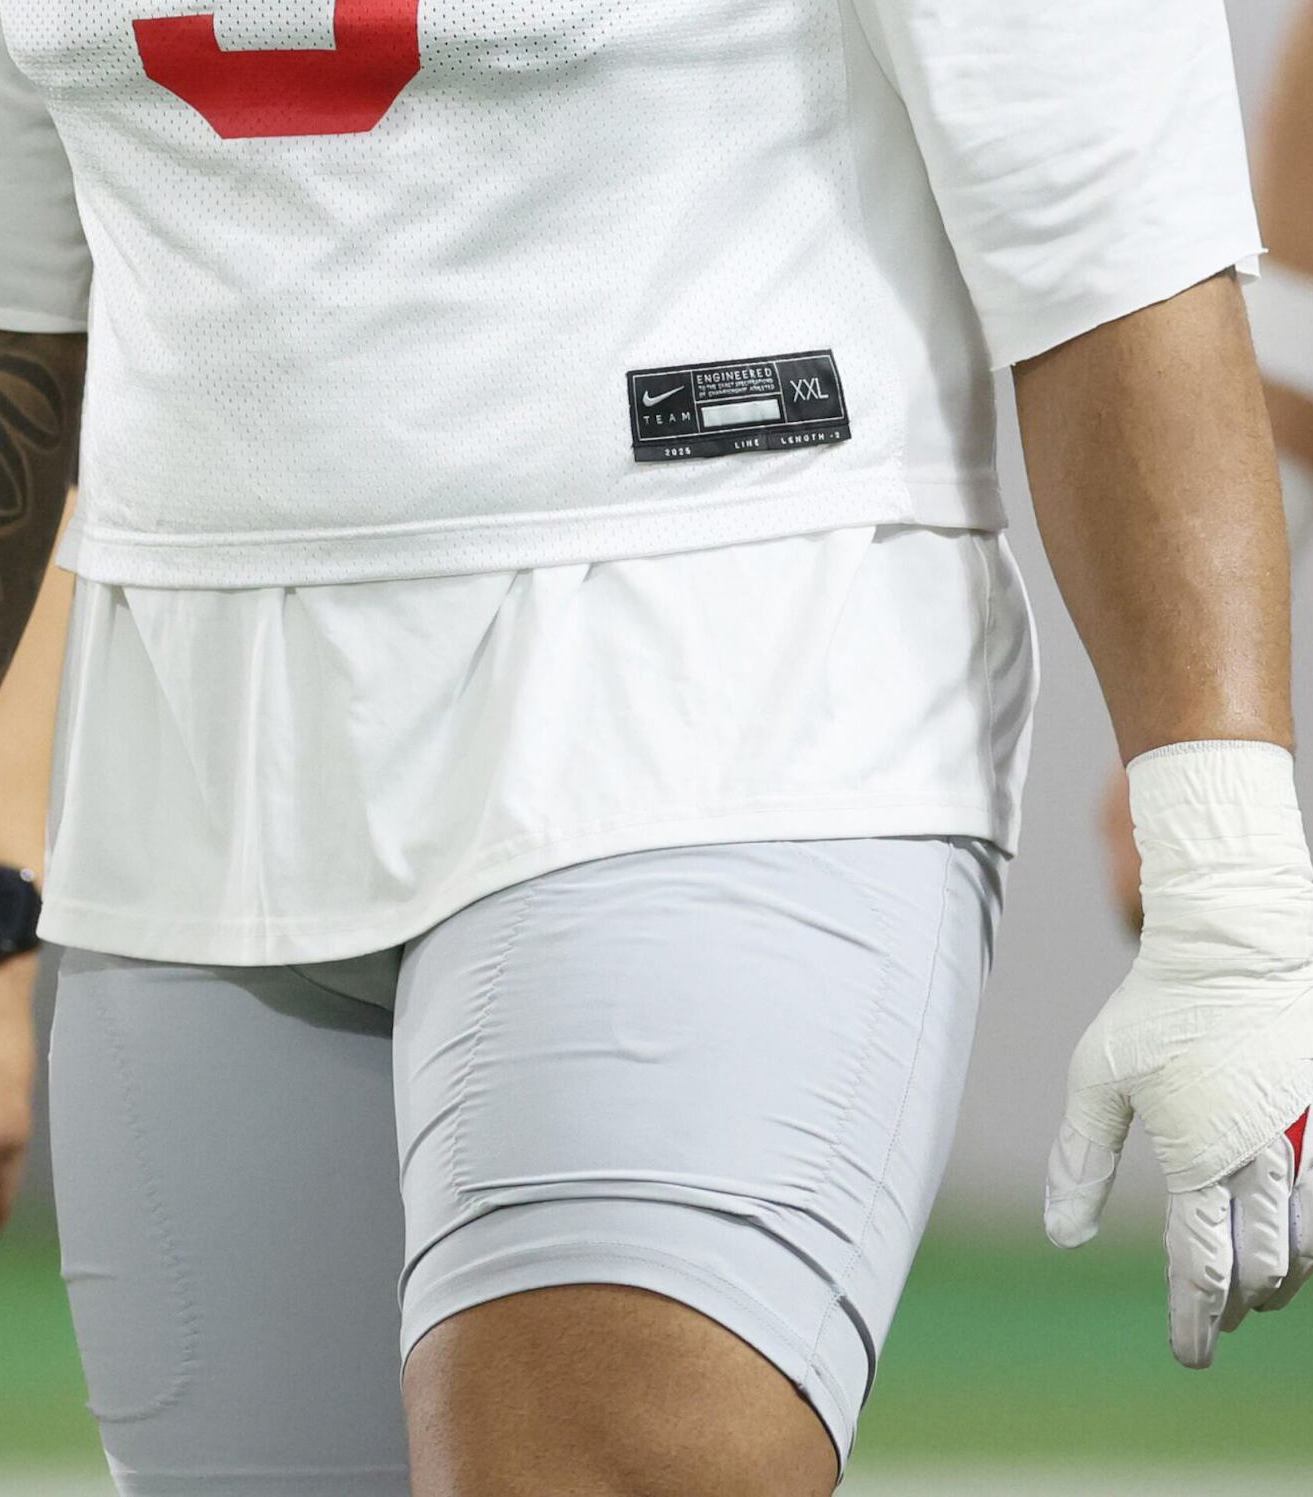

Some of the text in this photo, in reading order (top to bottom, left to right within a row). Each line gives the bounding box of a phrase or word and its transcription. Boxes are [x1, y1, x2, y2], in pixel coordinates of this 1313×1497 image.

[696, 367, 773, 385] ENGINEERED
[789, 377, 829, 403] XXL
[642, 412, 691, 425] TEAM
[734, 438, 760, 449] LINE
[780, 432, 825, 445] LENGTH
